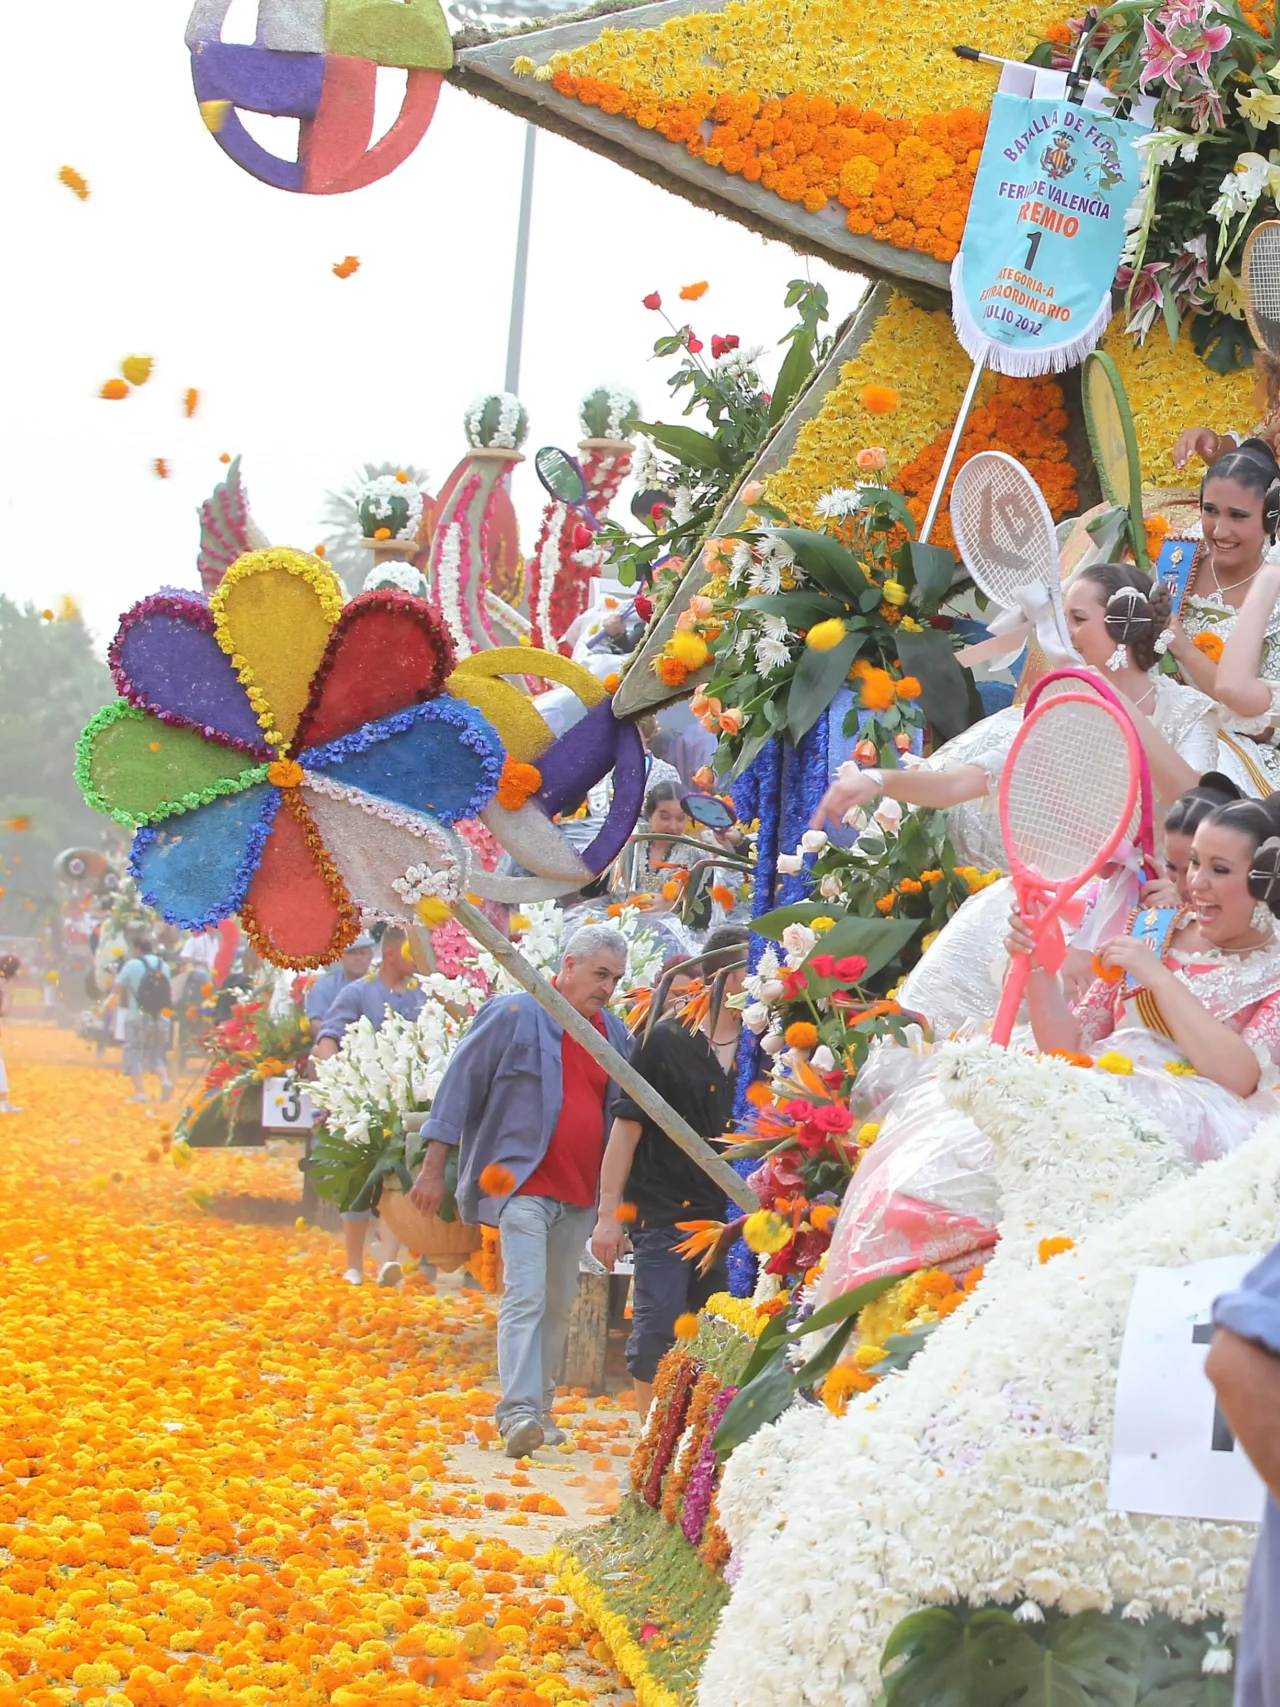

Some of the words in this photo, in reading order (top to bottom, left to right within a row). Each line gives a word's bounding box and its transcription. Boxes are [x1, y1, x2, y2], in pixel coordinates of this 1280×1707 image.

[1003, 111, 1058, 162] BATALLA
[1063, 111, 1085, 133] DE
[998, 181, 1027, 200] FERI
[1048, 184, 1110, 219] VALENCIA
[1017, 201, 1079, 238] REMIO
[1024, 231, 1042, 271] 1
[996, 267, 1055, 298] ATEGORIA-A
[1014, 314, 1043, 337] 2012
[281, 1079, 302, 1123] 3
